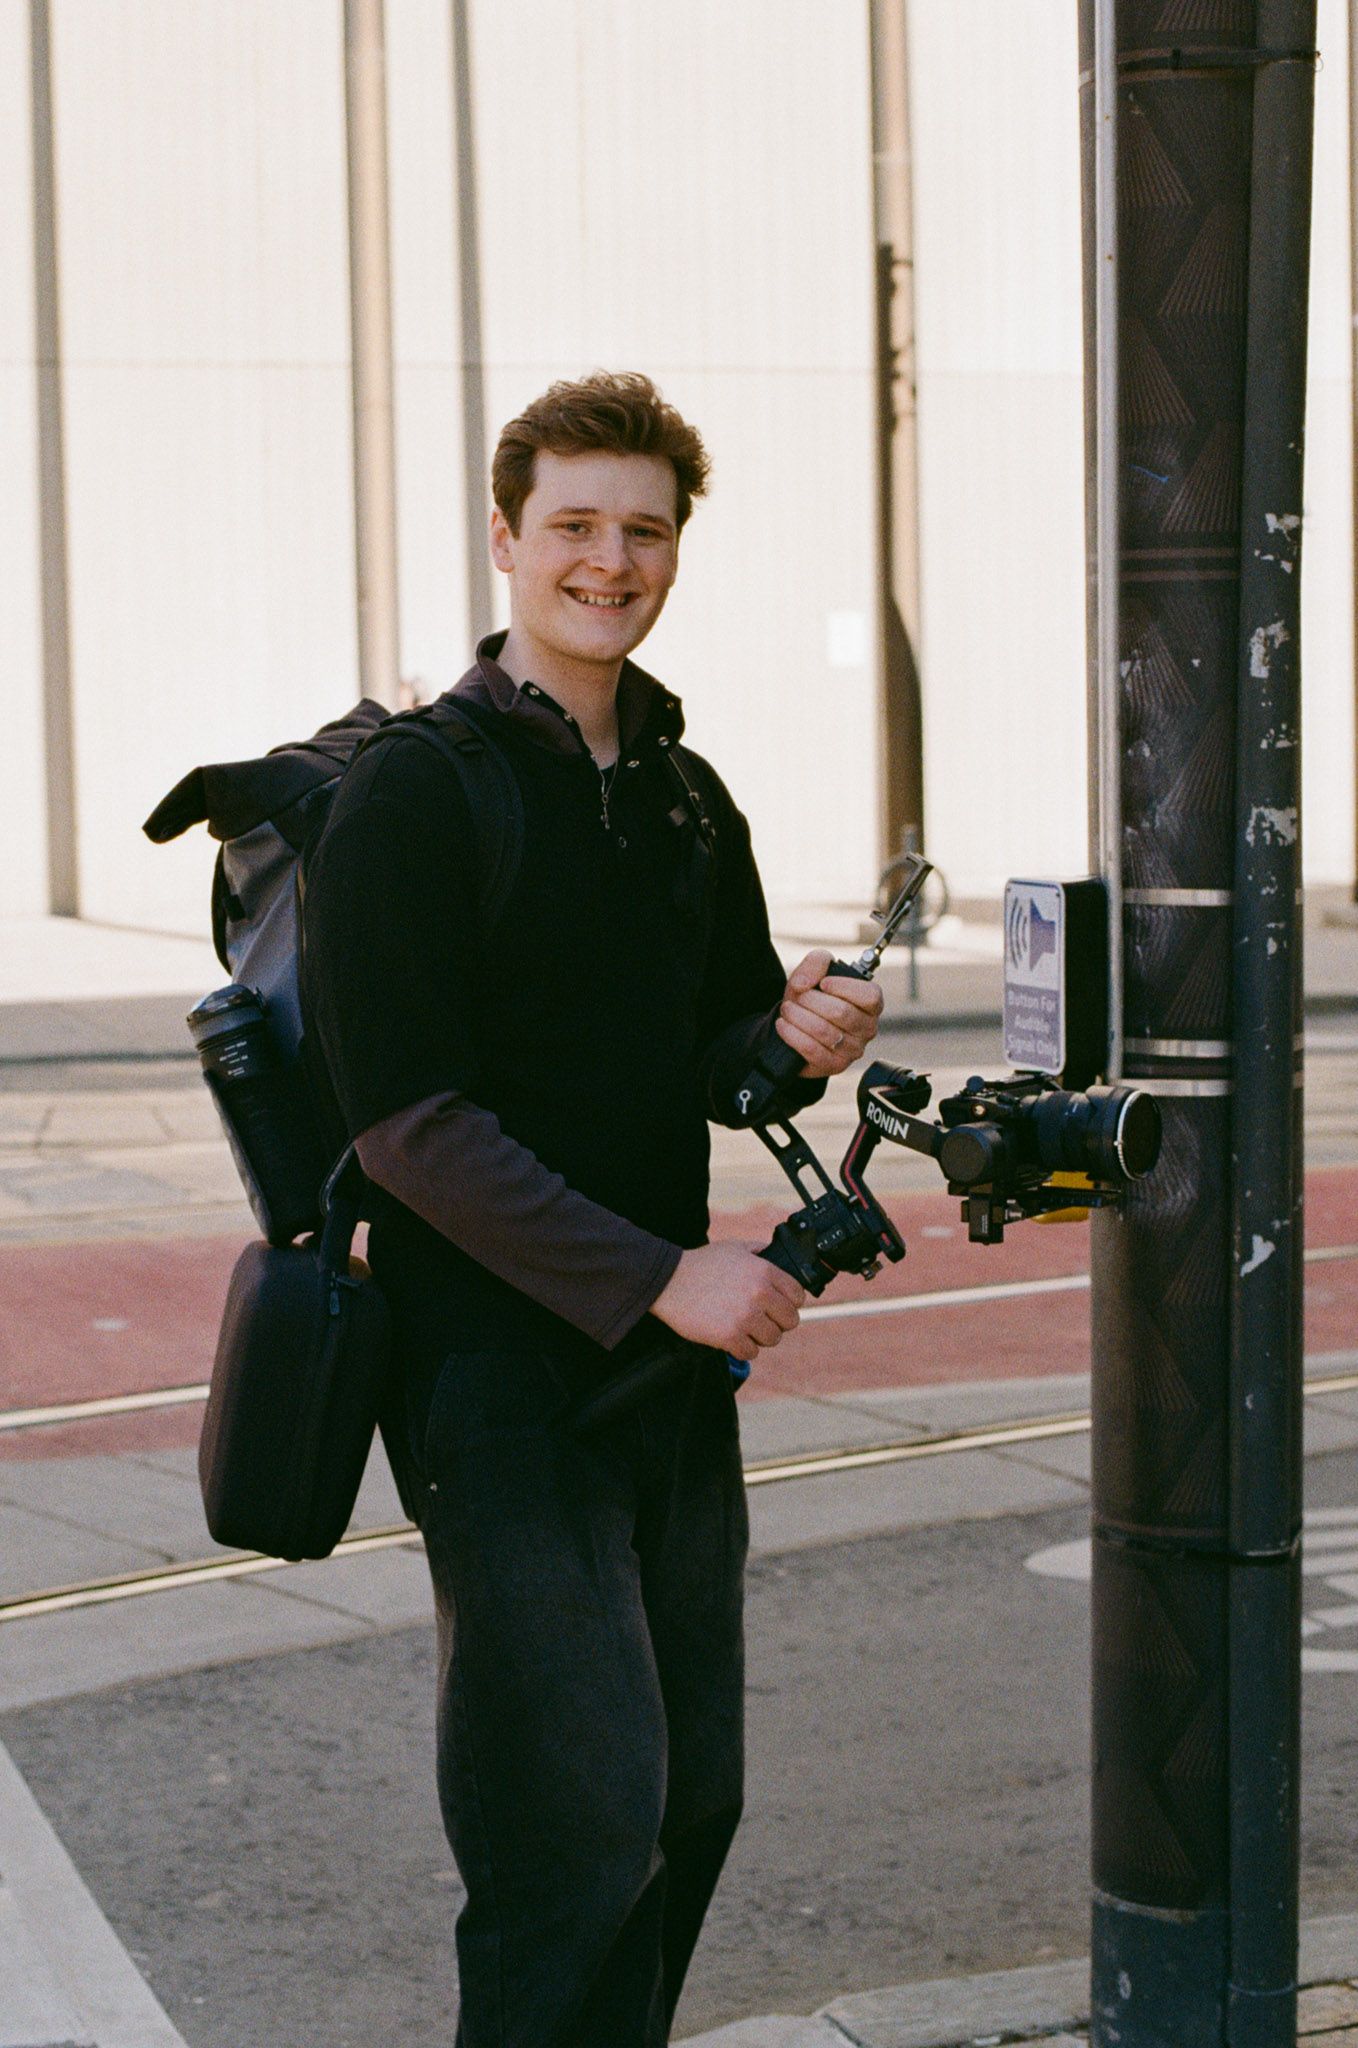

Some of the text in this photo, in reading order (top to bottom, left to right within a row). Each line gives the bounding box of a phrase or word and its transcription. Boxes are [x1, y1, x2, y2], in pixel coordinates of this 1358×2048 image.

[1008, 990, 1056, 1012] Button For
[1007, 1034, 1035, 1054] Signal
[866, 1101, 910, 1140] RONIN
